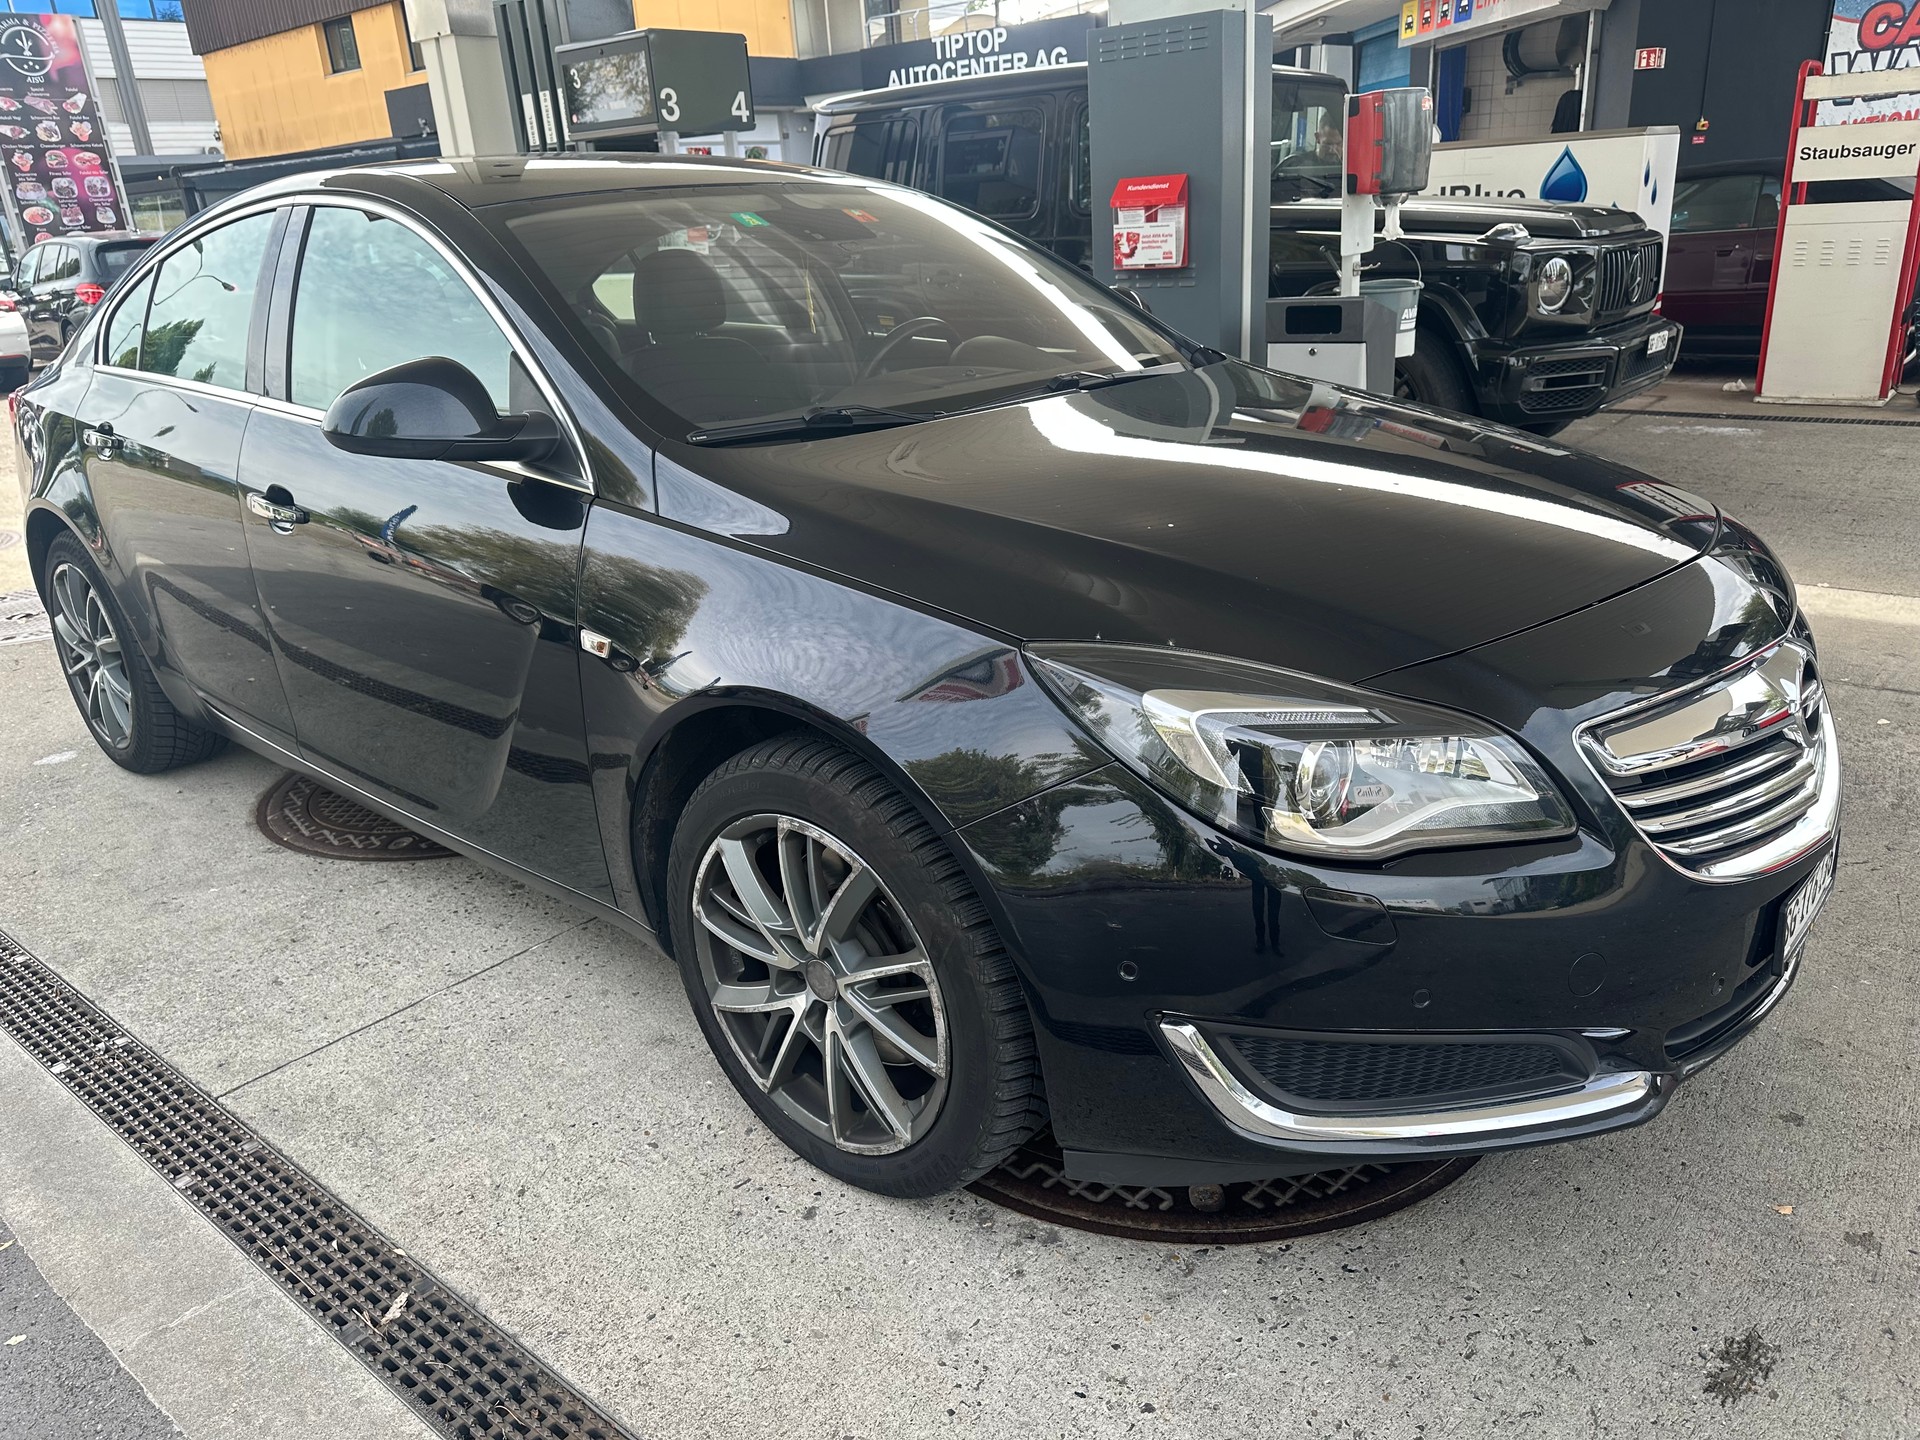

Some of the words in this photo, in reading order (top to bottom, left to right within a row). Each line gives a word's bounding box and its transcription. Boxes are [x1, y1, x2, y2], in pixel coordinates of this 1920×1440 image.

[931, 27, 1008, 60] TIPTOP
[570, 68, 581, 89] 3
[887, 52, 1028, 88] AUTOCENTER
[1034, 46, 1068, 67] AG
[26, 76, 45, 84] AISU
[660, 87, 680, 122] 3
[731, 91, 750, 123] 4
[529, 115, 537, 145] DIESEL
[1799, 143, 1917, 161] Staubsauger
[1127, 182, 1170, 192] Kundendienst
